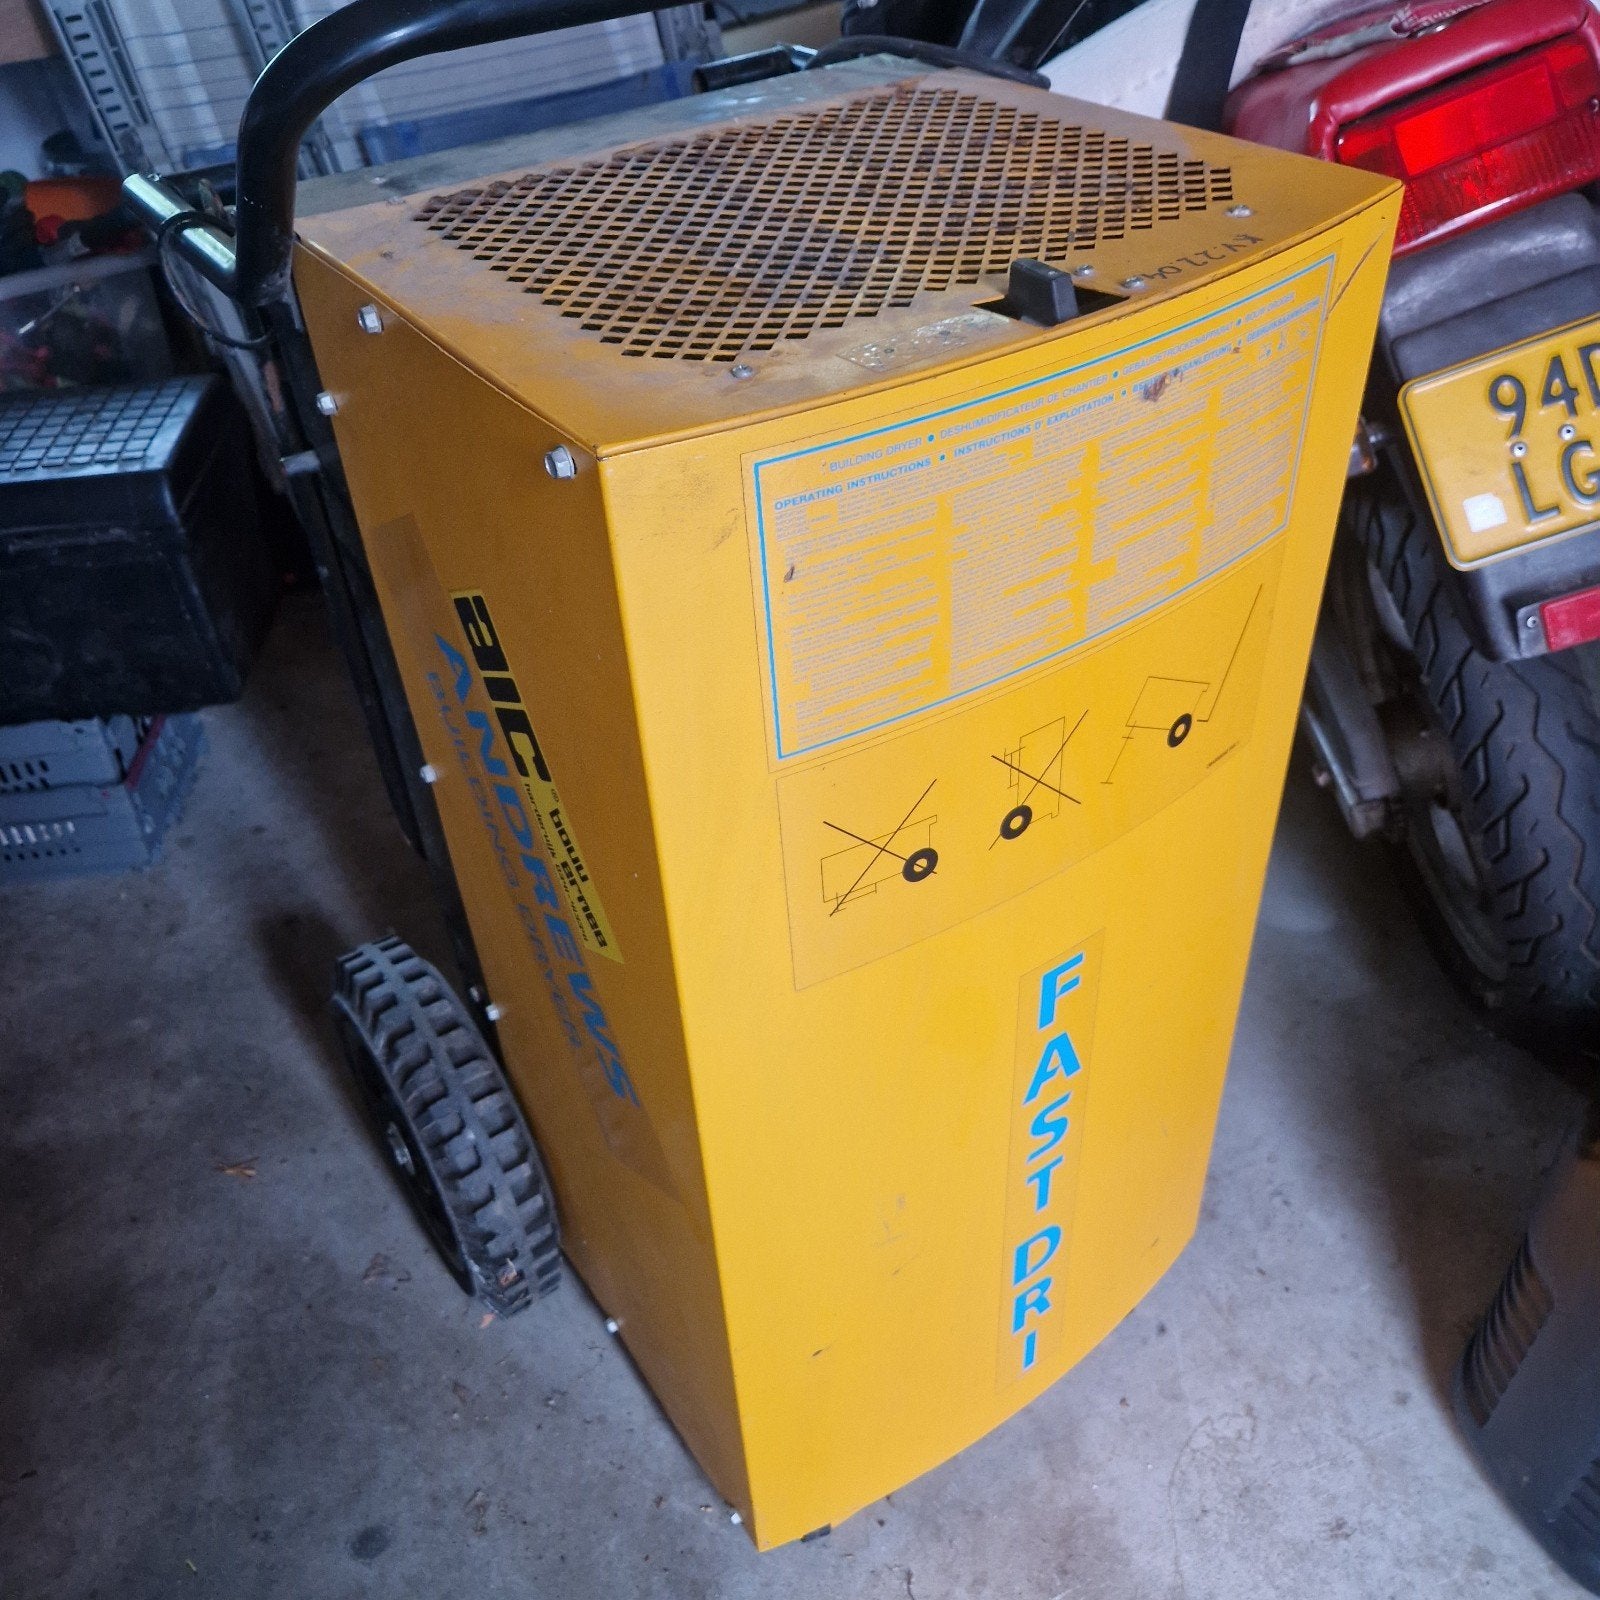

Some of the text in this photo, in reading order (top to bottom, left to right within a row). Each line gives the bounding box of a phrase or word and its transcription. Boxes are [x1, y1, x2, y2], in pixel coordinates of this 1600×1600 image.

[774, 484, 843, 511] OPERATING
[847, 457, 931, 491] INSTRUCTIONS
[954, 421, 1031, 458] INSTRUCTIONS
[1046, 393, 1115, 427] EXPLOITATION
[829, 449, 883, 472] BUILDING
[885, 437, 923, 456] DRYER
[1062, 374, 1108, 398] CHANTIER
[433, 632, 642, 1108] ANDREWS
[1012, 951, 1085, 1370] FAST DRI
